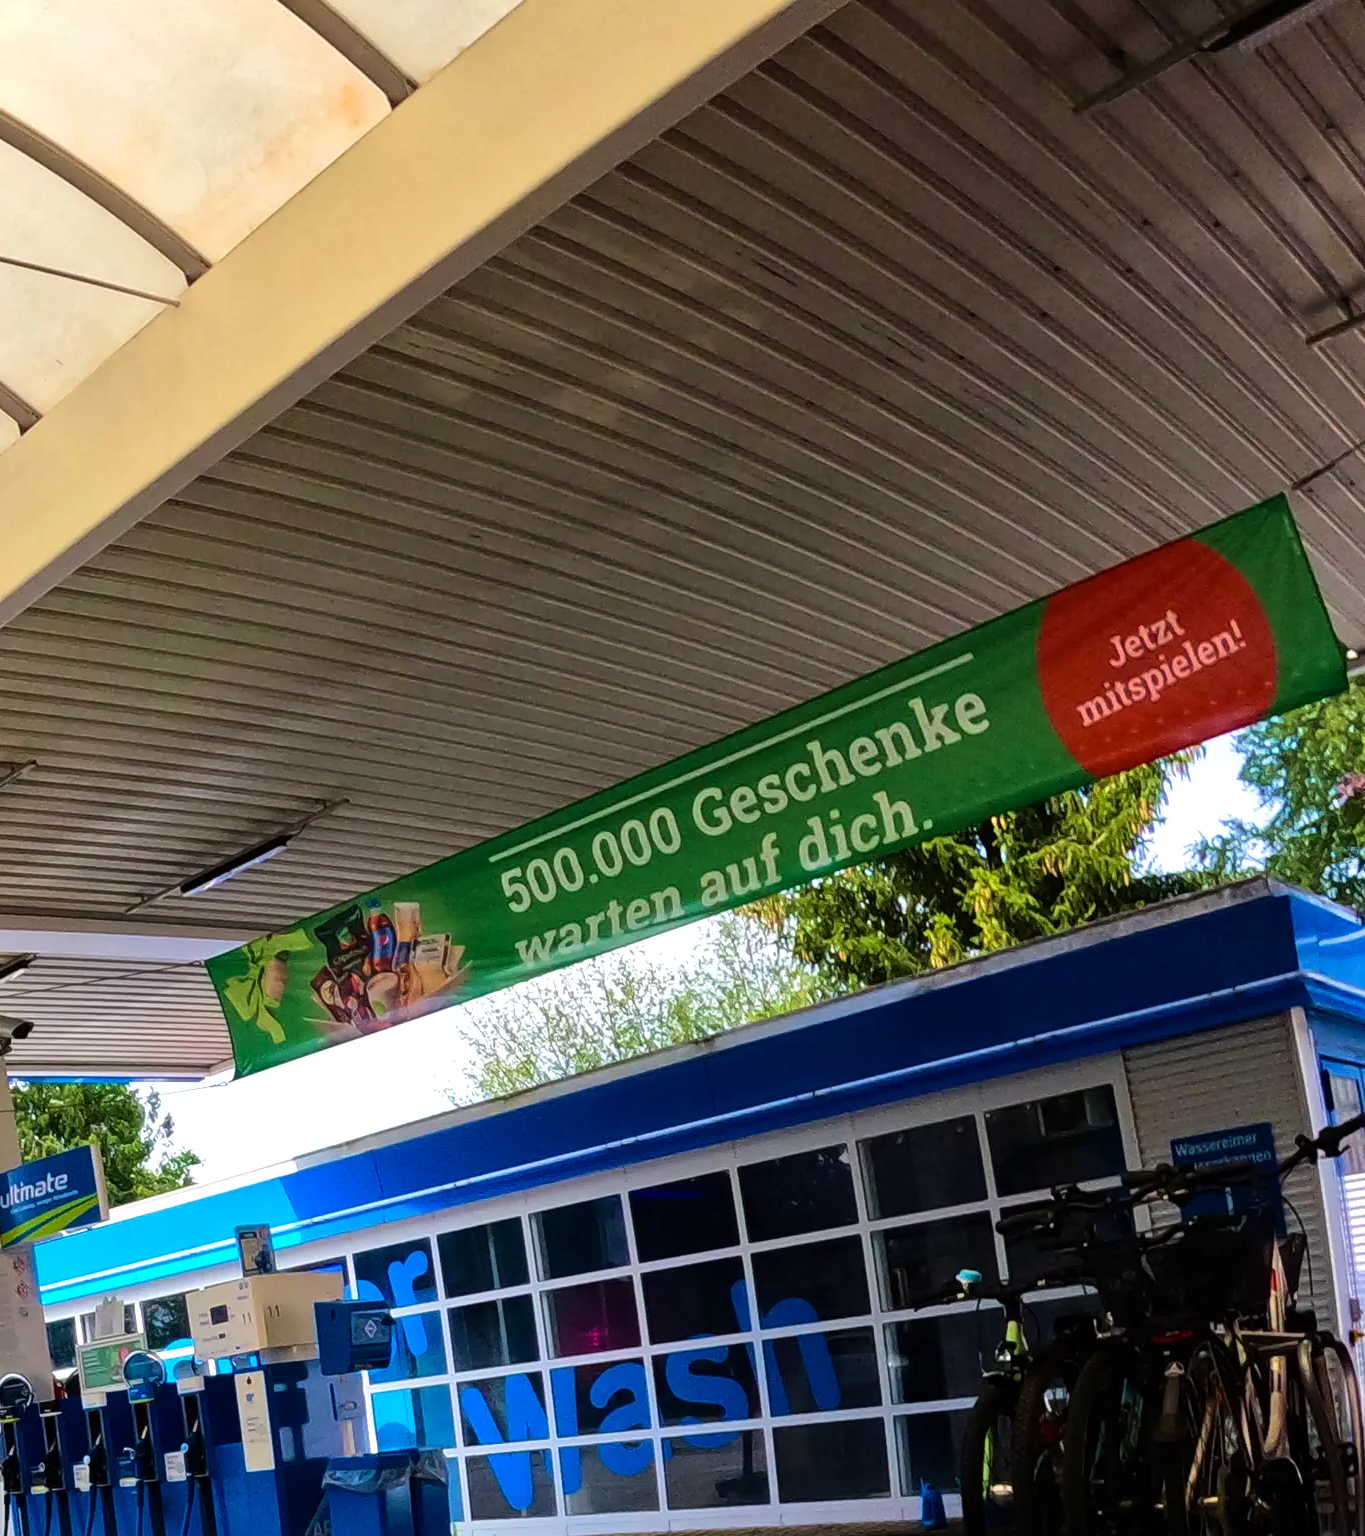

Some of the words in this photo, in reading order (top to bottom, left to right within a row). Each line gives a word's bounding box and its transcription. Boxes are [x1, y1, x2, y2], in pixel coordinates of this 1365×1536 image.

[1076, 618, 1247, 727] mitspielen!
[1109, 609, 1185, 668] Jetzt
[498, 807, 683, 914] 500.000
[691, 691, 991, 837] Geschenke
[514, 884, 685, 967] warten
[700, 832, 783, 907] auf
[797, 791, 935, 873] dich.
[1174, 1132, 1257, 1157] Wassereimer
[0, 1172, 68, 1209] ultimate
[267, 1304, 281, 1318] 11
[462, 1278, 842, 1511] Wash
